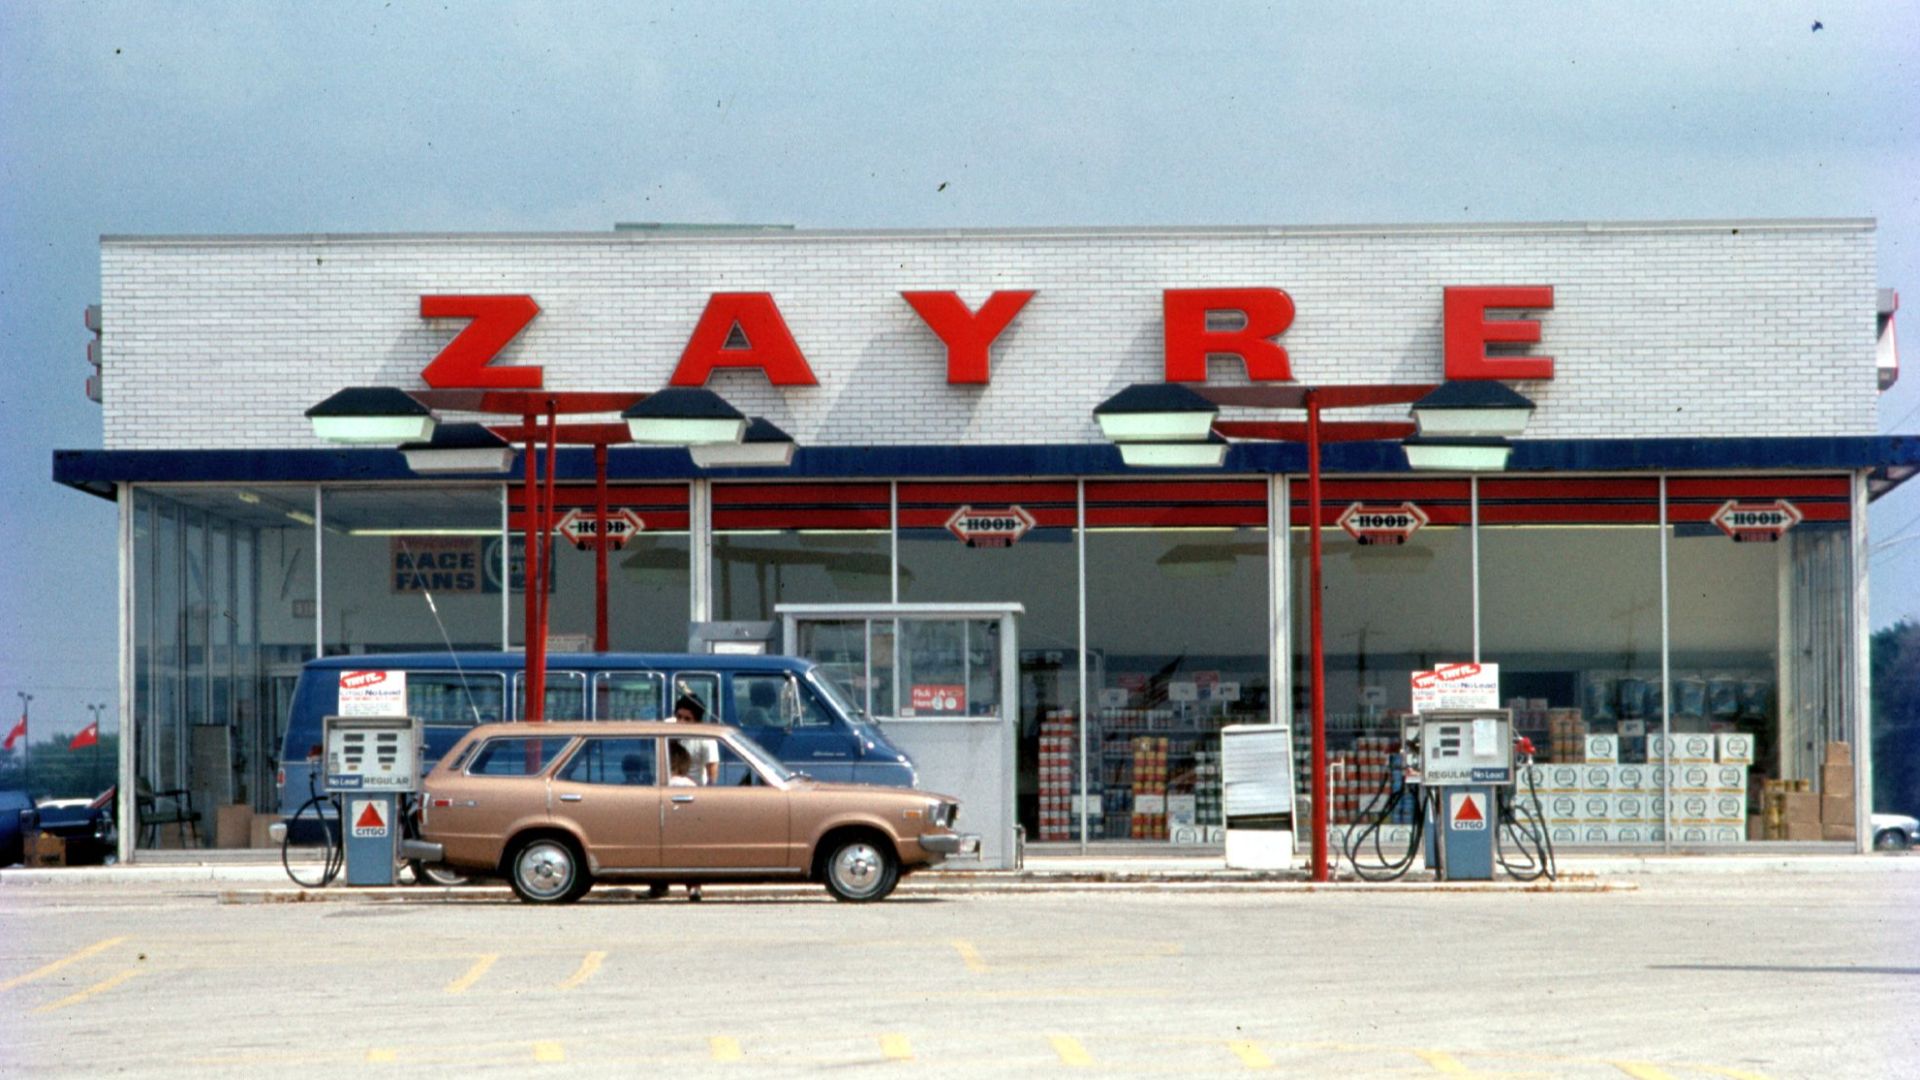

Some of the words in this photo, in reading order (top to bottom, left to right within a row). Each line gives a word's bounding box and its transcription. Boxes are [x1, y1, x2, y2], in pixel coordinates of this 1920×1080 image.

[420, 285, 1555, 388] ZAYRE
[967, 518, 1016, 530] HOOD
[1359, 515, 1408, 527] HOOD
[1733, 513, 1782, 525] HOOD
[396, 552, 475, 569] RACE
[396, 572, 475, 590] FANS
[329, 777, 339, 785] No
[341, 777, 359, 785] Lead
[363, 777, 408, 785] REGULAR
[1428, 771, 1472, 779] REGULAR
[1454, 821, 1483, 829] CITGO
[356, 828, 385, 836] CITGO
